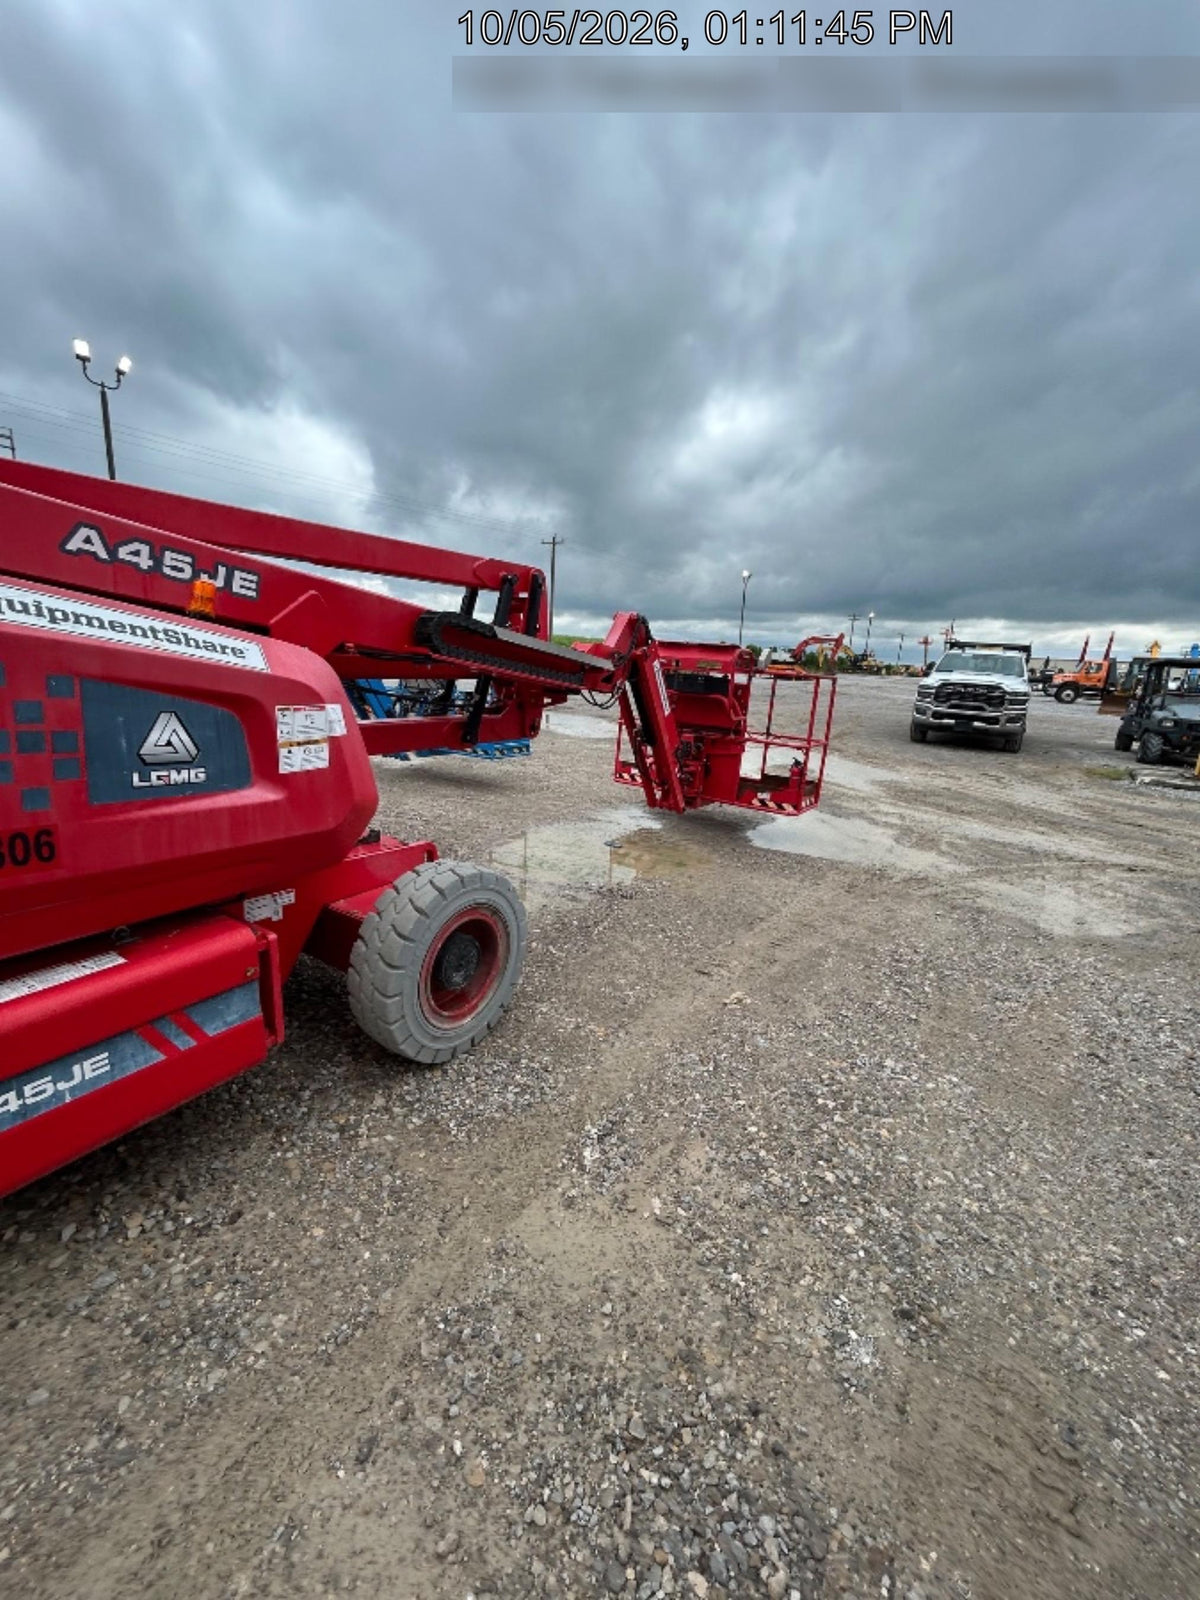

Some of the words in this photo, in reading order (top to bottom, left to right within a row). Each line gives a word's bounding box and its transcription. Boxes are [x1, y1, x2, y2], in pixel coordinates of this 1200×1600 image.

[61, 523, 259, 599] A45JE
[132, 767, 207, 788] LGMG
[0, 829, 56, 868] 06
